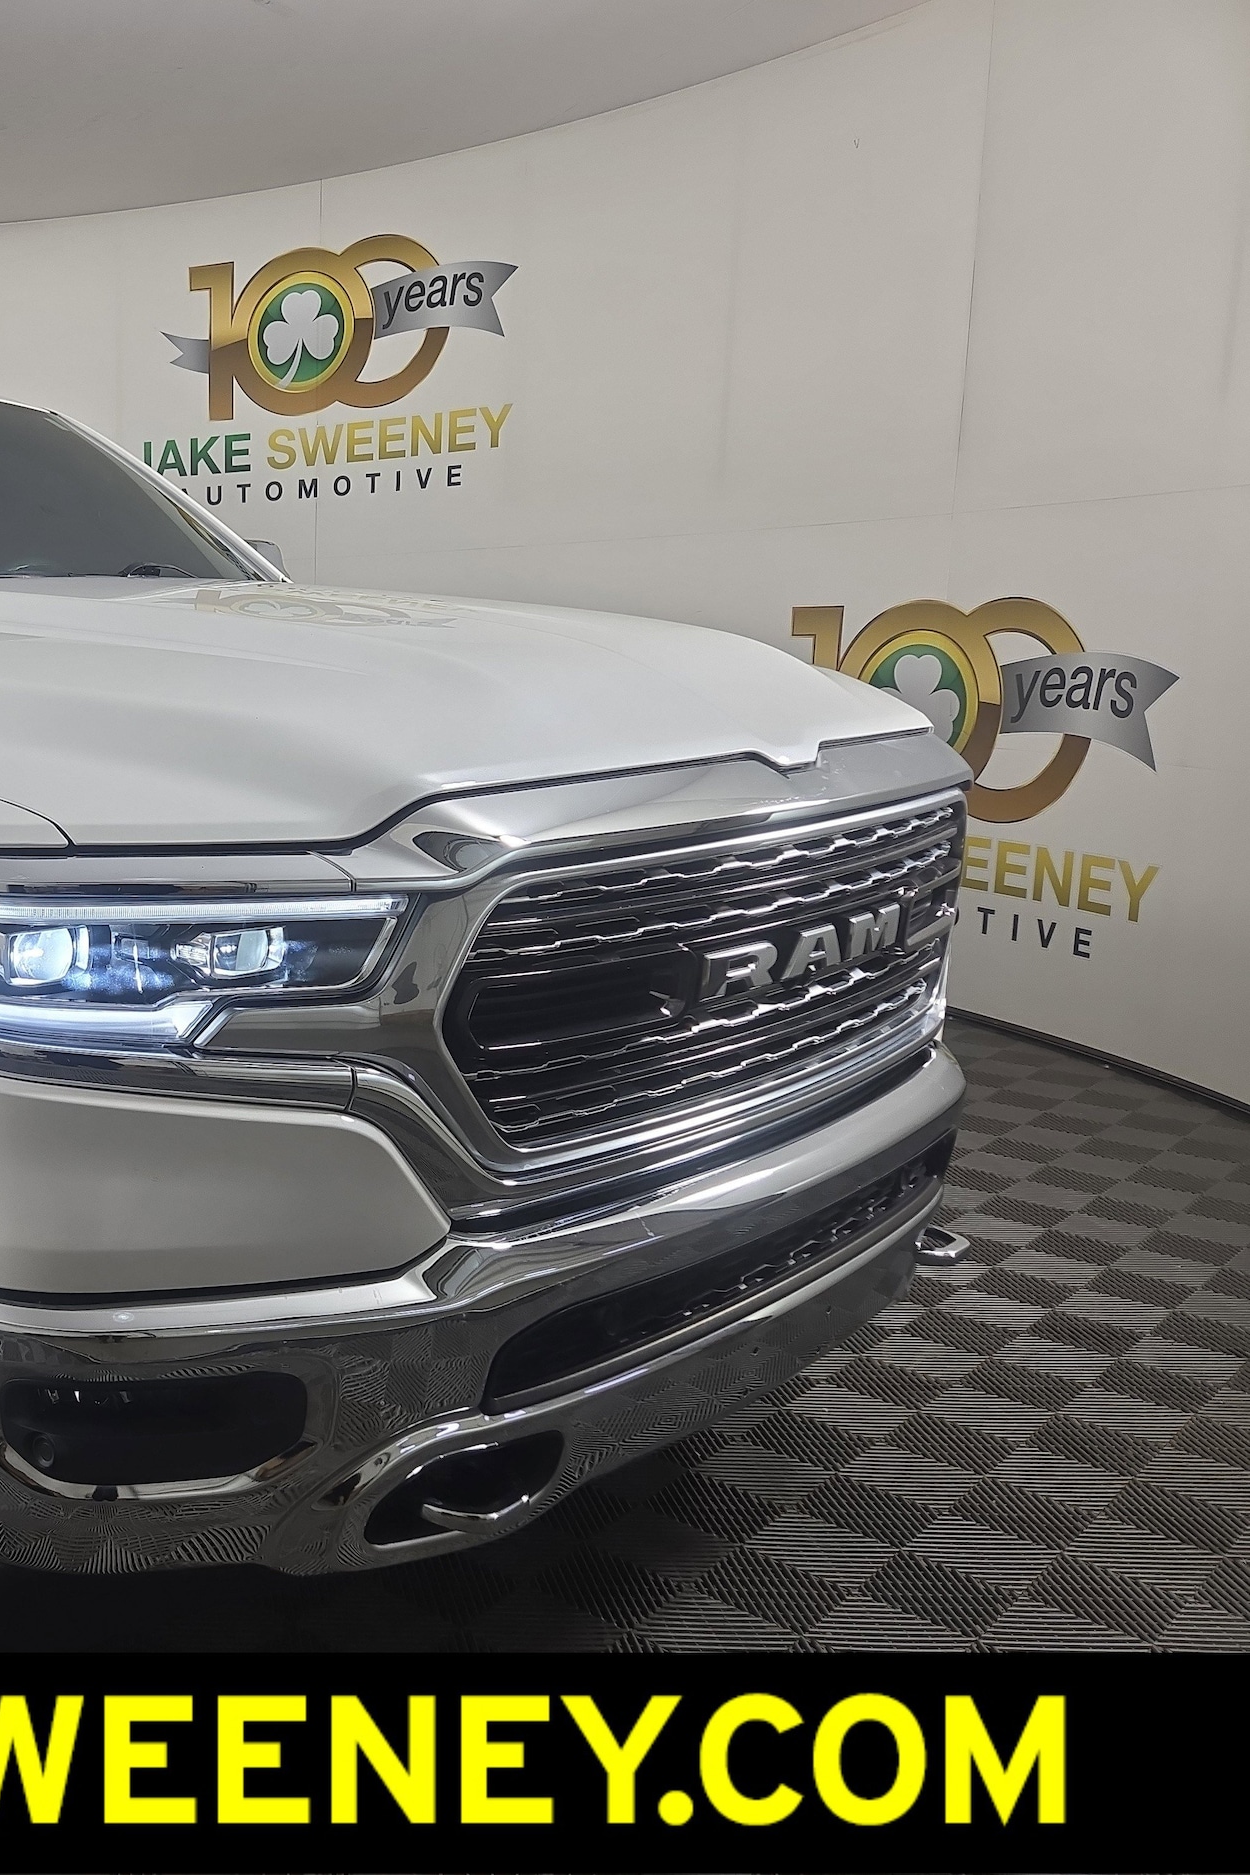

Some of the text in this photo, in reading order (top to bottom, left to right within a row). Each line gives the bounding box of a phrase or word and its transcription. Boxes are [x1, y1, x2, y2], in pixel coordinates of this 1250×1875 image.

[188, 234, 485, 421] 100 years
[266, 403, 514, 471] SWEENEY
[181, 464, 463, 506] UTOMOTIVE
[1009, 664, 1138, 723] years
[701, 901, 901, 1002] RAM
[954, 906, 1093, 959] TIVE
